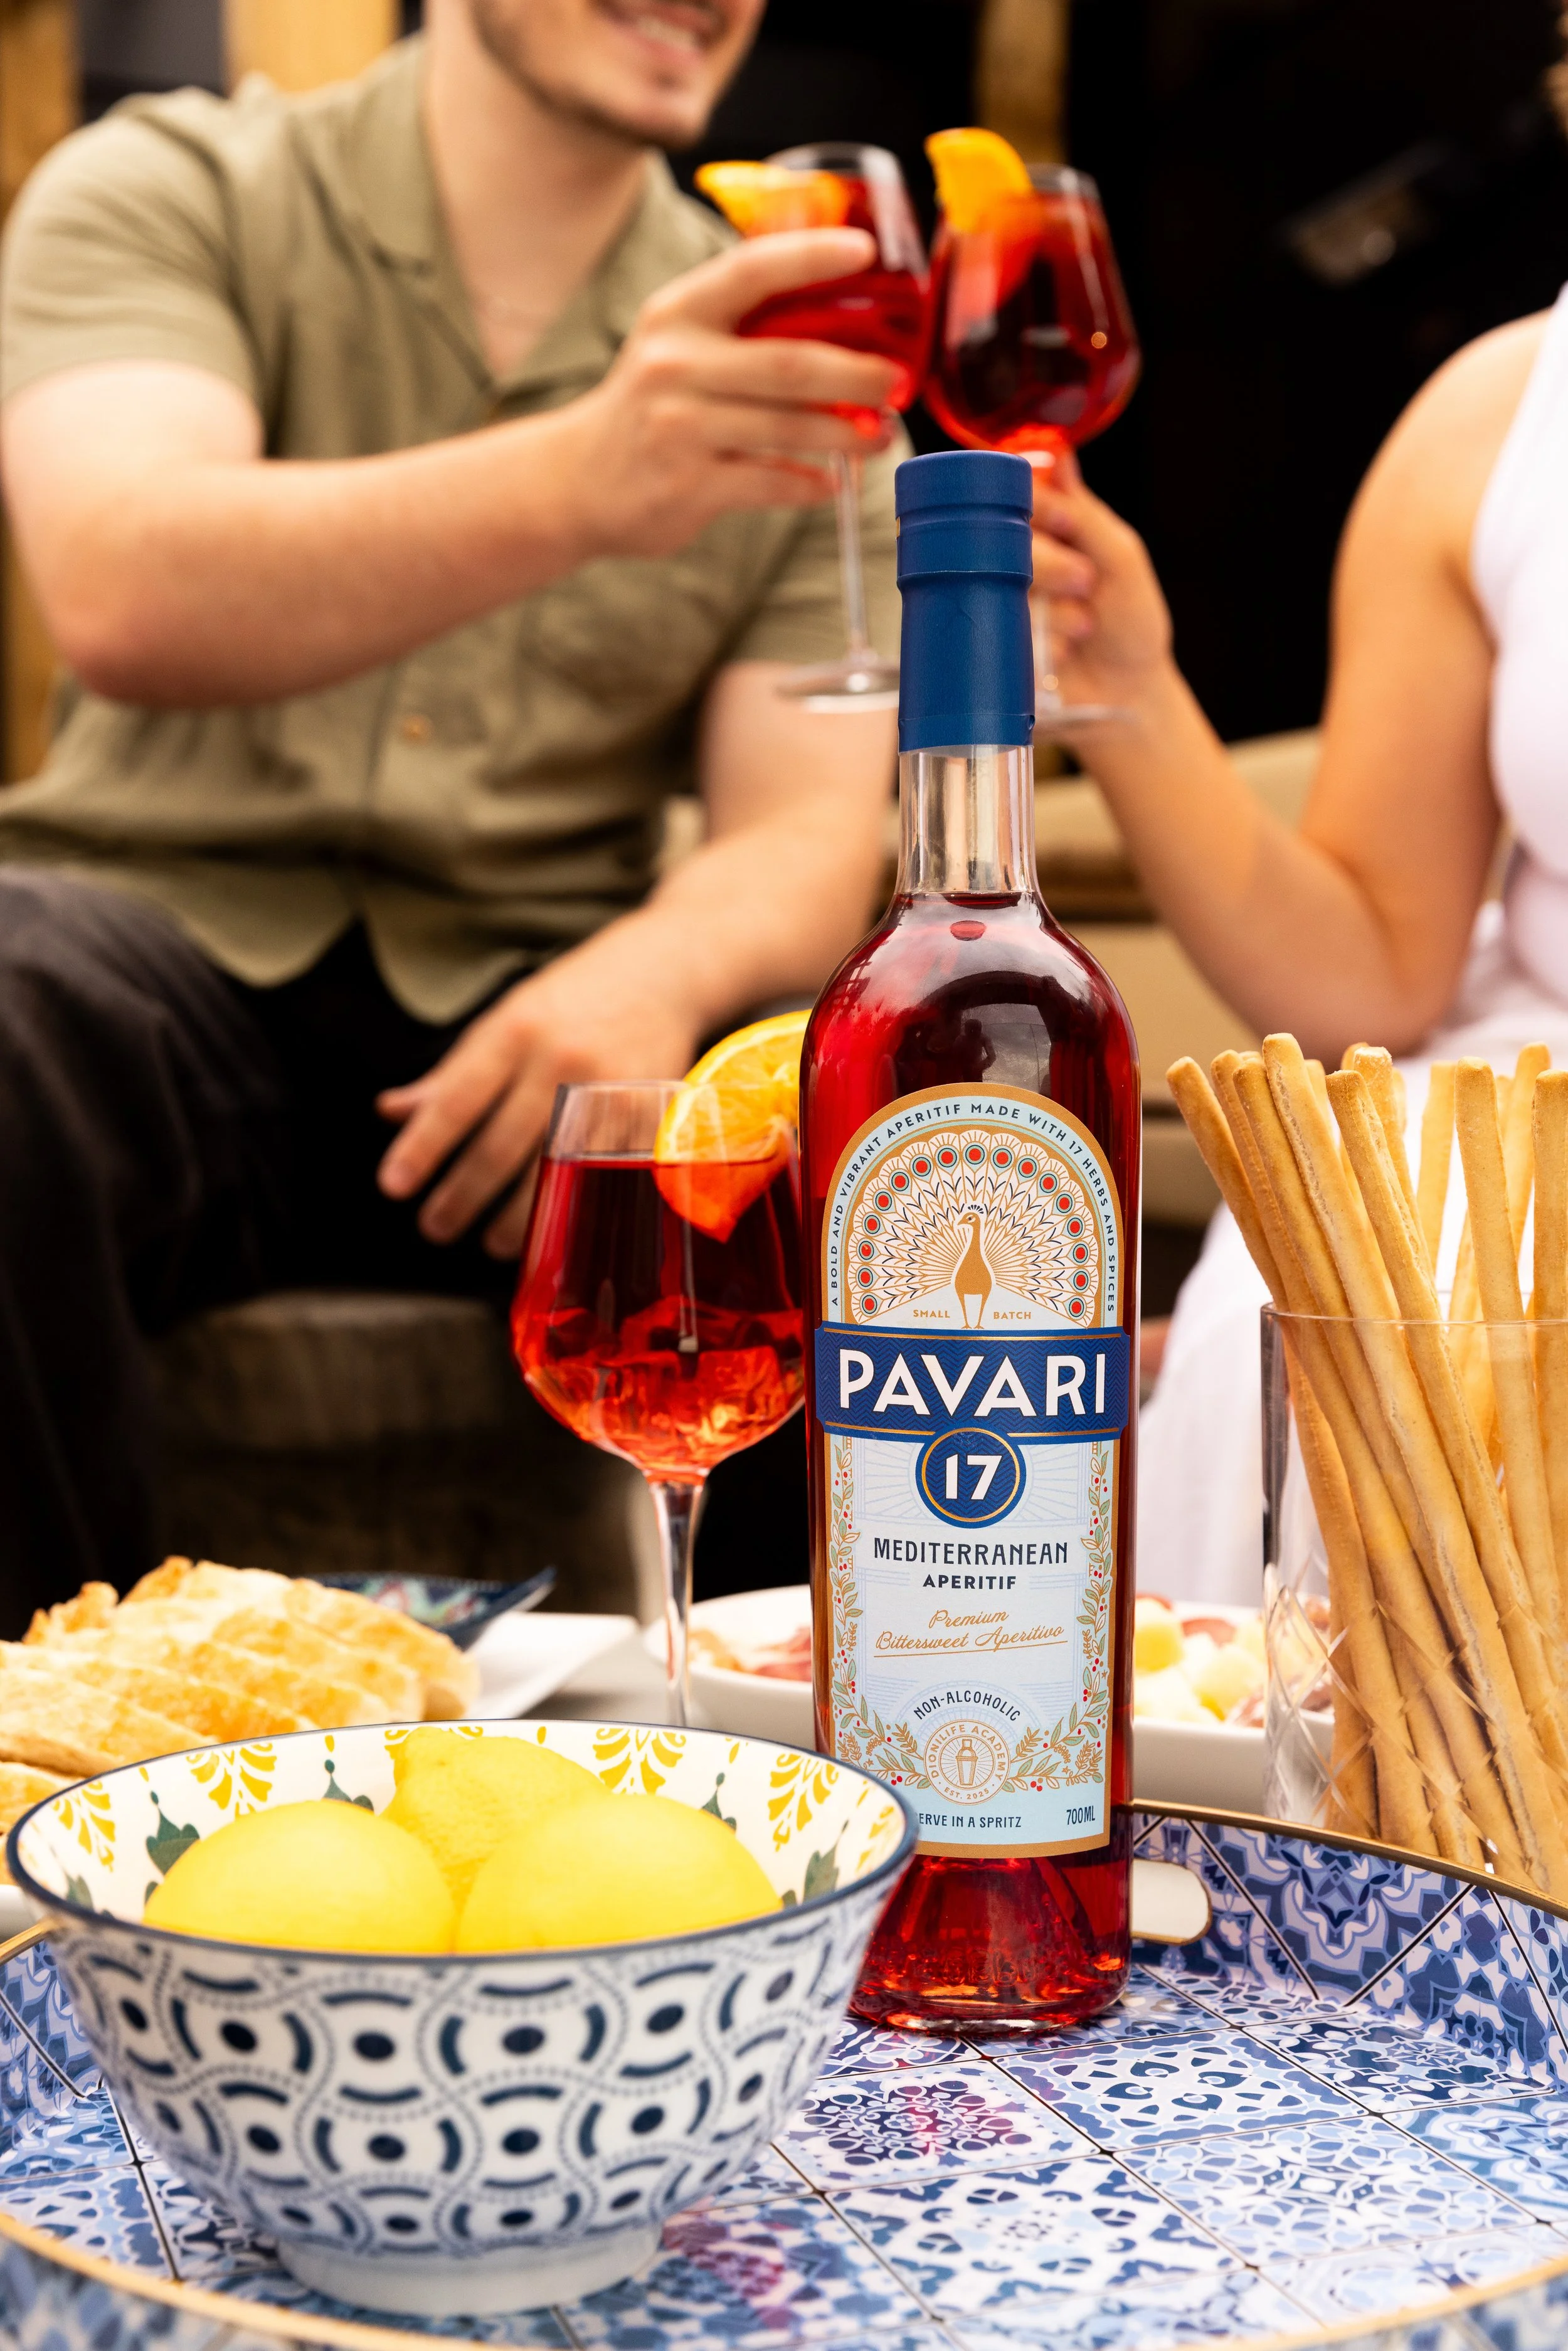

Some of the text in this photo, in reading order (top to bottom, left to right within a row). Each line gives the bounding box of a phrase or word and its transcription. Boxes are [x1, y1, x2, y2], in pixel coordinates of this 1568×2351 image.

[886, 1104, 960, 1138] APERITIF
[971, 1103, 1020, 1119] MADE
[1029, 1113, 1066, 1141] WITH
[1069, 1140, 1083, 1154] 17
[840, 1137, 881, 1196] VIBRANT
[1082, 1158, 1108, 1206] HERBS
[832, 1205, 843, 1238] AND
[1104, 1214, 1114, 1246] AND
[832, 1297, 838, 1306] A
[913, 1309, 1032, 1320] SMALL BATCH
[839, 1349, 1106, 1416] PAVARI
[945, 1453, 1002, 1500] 17
[874, 1537, 1067, 1566] MEDITERRANEAN
[923, 1574, 1017, 1589] APERITIF
[928, 1610, 1009, 1629] Premium
[876, 1625, 1064, 1652] Bittersweet Aperitivo
[913, 1690, 1020, 1721] NON-ALCOHOLIC
[928, 1724, 1006, 1781] DIONILIFE ACADEMY
[944, 1787, 989, 1800] EST. 2025
[916, 1812, 1022, 1828] ERVE IN A SPRITZ
